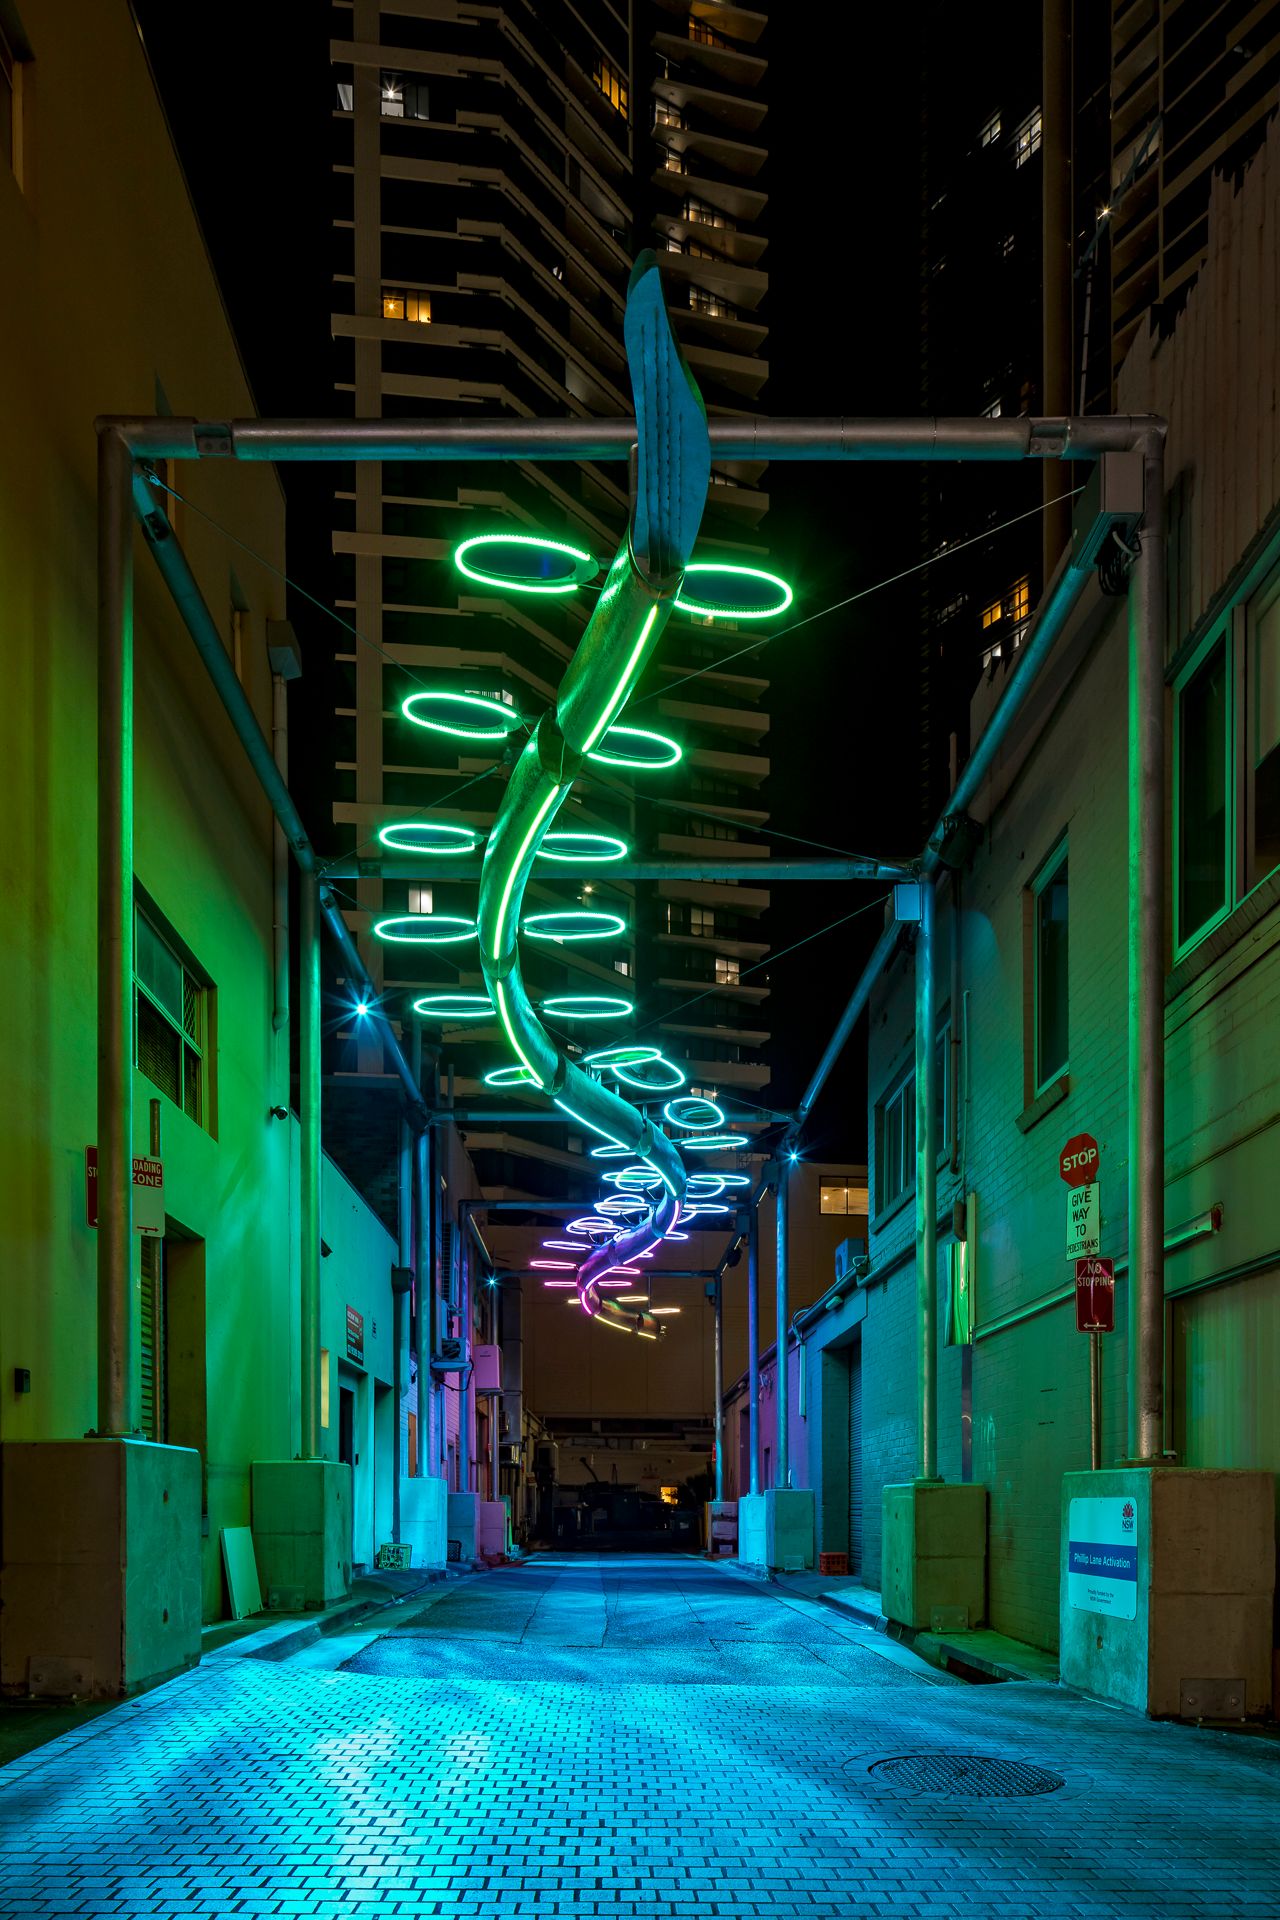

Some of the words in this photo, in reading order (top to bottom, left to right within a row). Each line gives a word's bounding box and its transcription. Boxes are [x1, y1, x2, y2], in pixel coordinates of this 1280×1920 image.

[132, 1160, 161, 1175] OADING
[1062, 1148, 1097, 1172] STOP
[132, 1172, 162, 1187] ZONE
[1071, 1190, 1092, 1207] GIVE
[1072, 1206, 1090, 1222] WAY
[1075, 1223, 1087, 1237] TO
[1067, 1238, 1099, 1255] PEDESTRIANS
[1087, 1262, 1102, 1274] NO
[1077, 1275, 1112, 1287] STOPPING
[1122, 1520, 1134, 1530] NSW
[1074, 1552, 1089, 1566] Phillip
[1090, 1554, 1102, 1565] Lane
[1103, 1556, 1131, 1568] Activation
